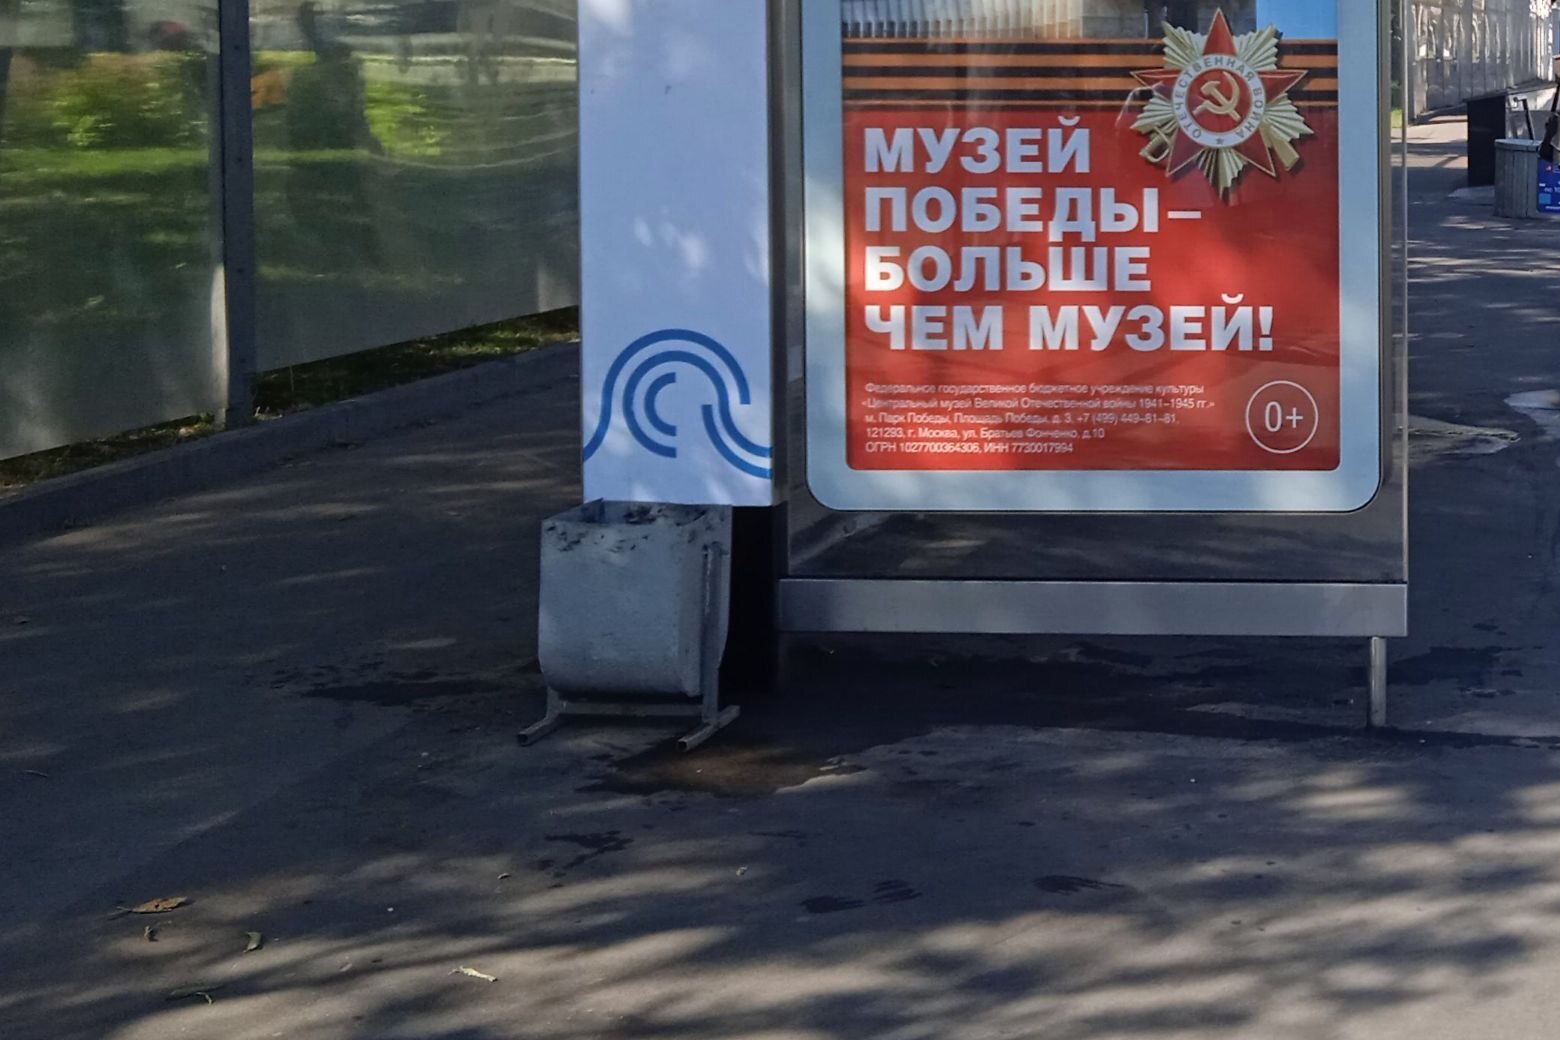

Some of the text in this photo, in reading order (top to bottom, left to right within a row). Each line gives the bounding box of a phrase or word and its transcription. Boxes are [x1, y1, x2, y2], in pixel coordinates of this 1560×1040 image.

[1175, 56, 1255, 139] ОТЕЧЕСТВЕННАЯ
[864, 115, 1091, 174] МУЗЕЙ
[865, 245, 1152, 292] БОЛЬШЕ
[865, 293, 1274, 351] ЧЕМ МУЗЕЙ!
[865, 383, 1205, 396] Федеральное государственное бюджетное учреждение культуры
[940, 398, 972, 410] музей
[974, 398, 1019, 408] Великой
[1020, 398, 1101, 408] Отечественной
[1103, 398, 1137, 408] войны
[878, 413, 906, 424] Парк
[954, 413, 1003, 424] Площадь
[1077, 413, 1089, 422] +7
[1265, 401, 1304, 432] 0+
[907, 429, 917, 438] г.
[980, 428, 1024, 440] Братьев
[865, 442, 896, 452] ОГРН
[984, 442, 1009, 452] ИНН
